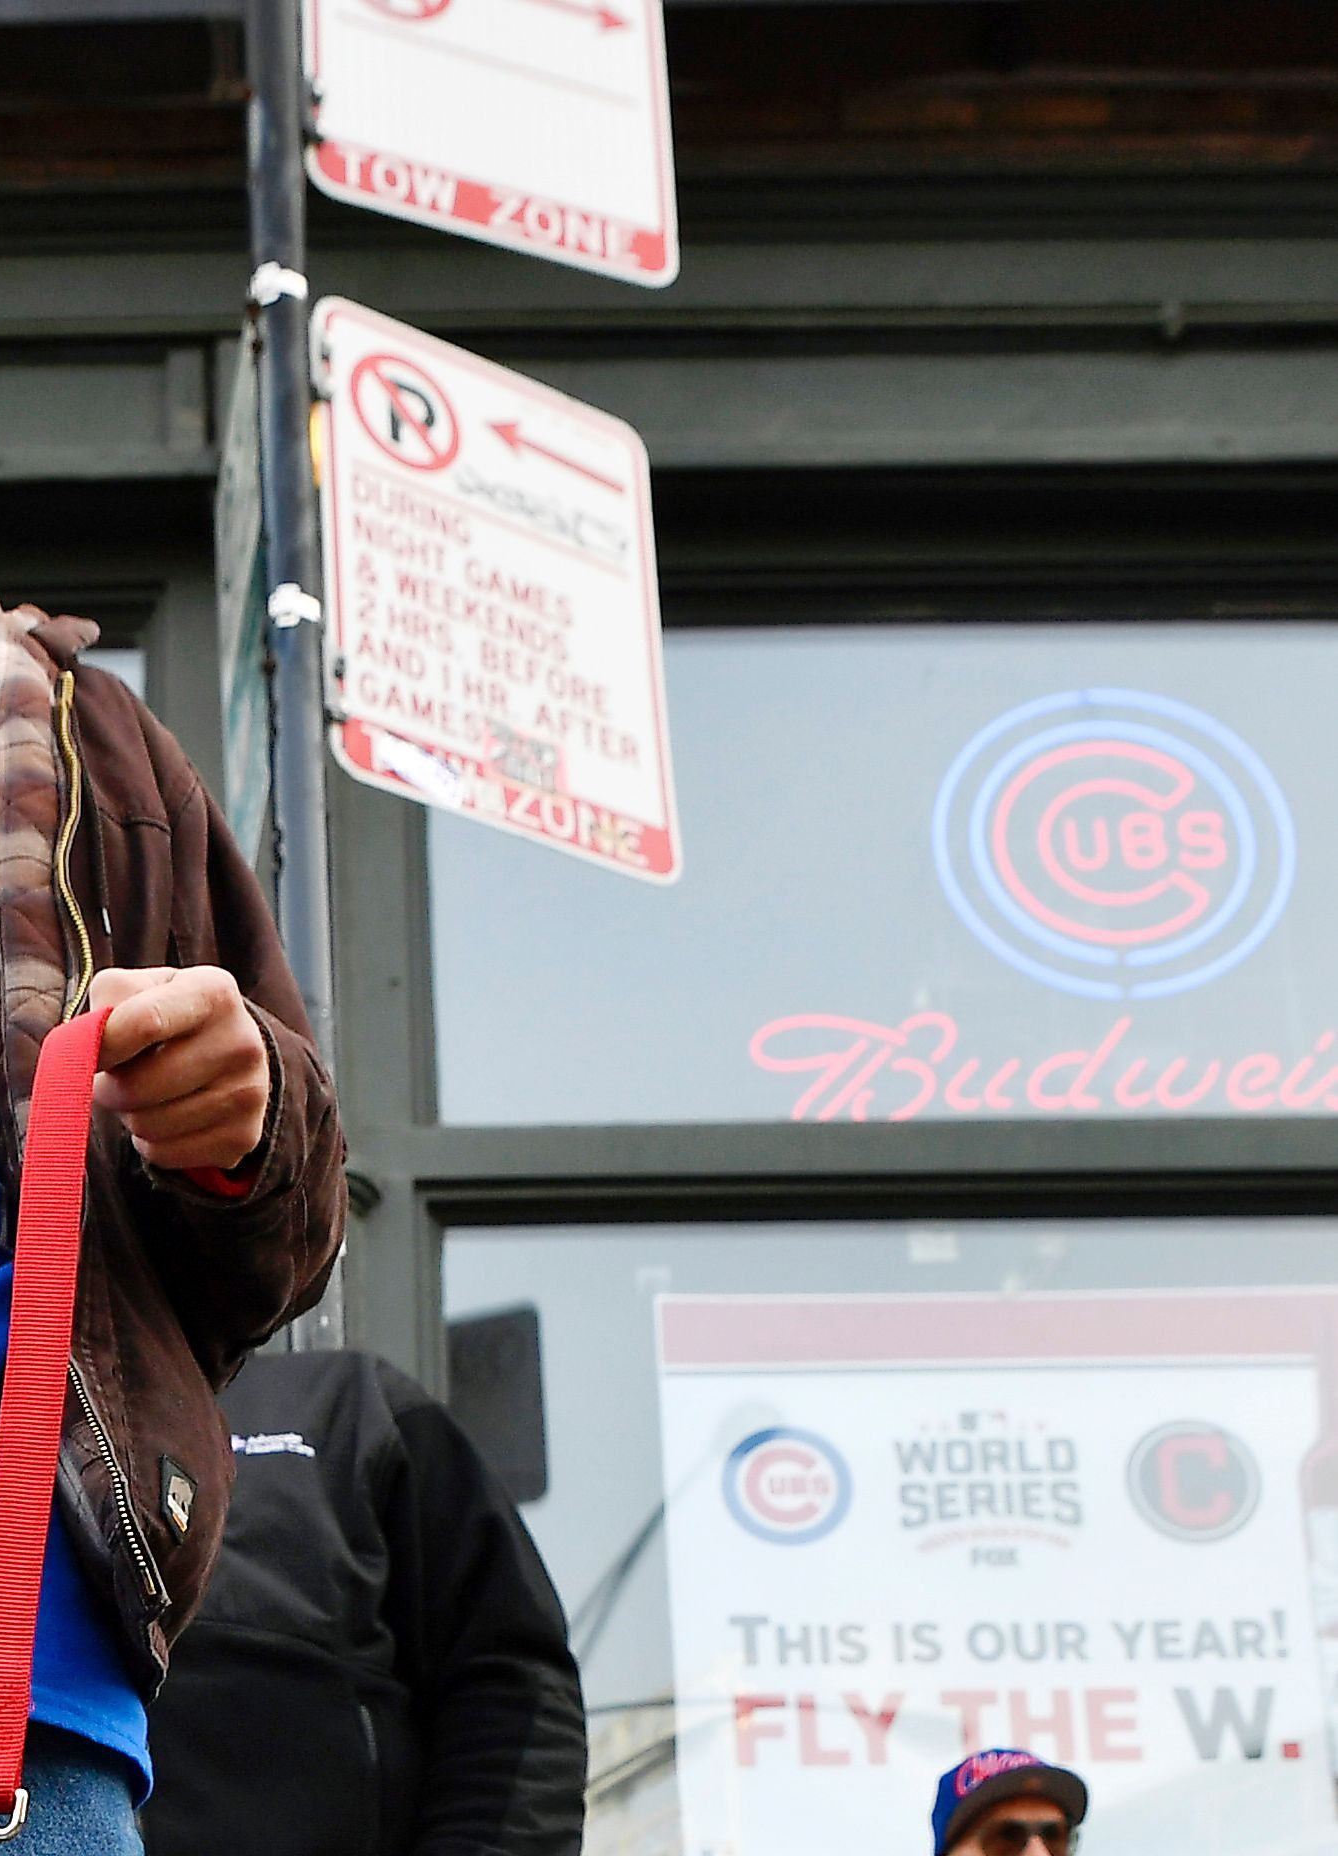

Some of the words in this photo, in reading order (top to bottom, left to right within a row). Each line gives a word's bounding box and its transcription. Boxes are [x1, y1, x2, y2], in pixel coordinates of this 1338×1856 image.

[334, 145, 458, 215] TOW
[487, 186, 642, 268] ZONE
[352, 472, 470, 546] DURING
[352, 512, 444, 574] NIGHT
[464, 559, 573, 630] GAMES
[394, 570, 569, 664] WEEKENDS
[357, 631, 428, 682] AND
[535, 704, 642, 767] AFTER
[360, 672, 484, 746] GAMES
[480, 637, 607, 717] BEFORE
[505, 785, 650, 868] ZONE
[992, 739, 1228, 945] CUBS
[749, 1012, 1338, 1122] Budwei
[894, 1437, 1078, 1477] WORLD
[899, 1480, 1084, 1530] SERIES
[730, 1614, 868, 1667] THIS
[894, 1621, 944, 1663] IS
[968, 1620, 1088, 1664] OUR
[1113, 1608, 1290, 1662] YEAR!
[733, 1691, 905, 1768] FLY
[941, 1687, 1144, 1764] THE
[1173, 1685, 1302, 1761] W.
